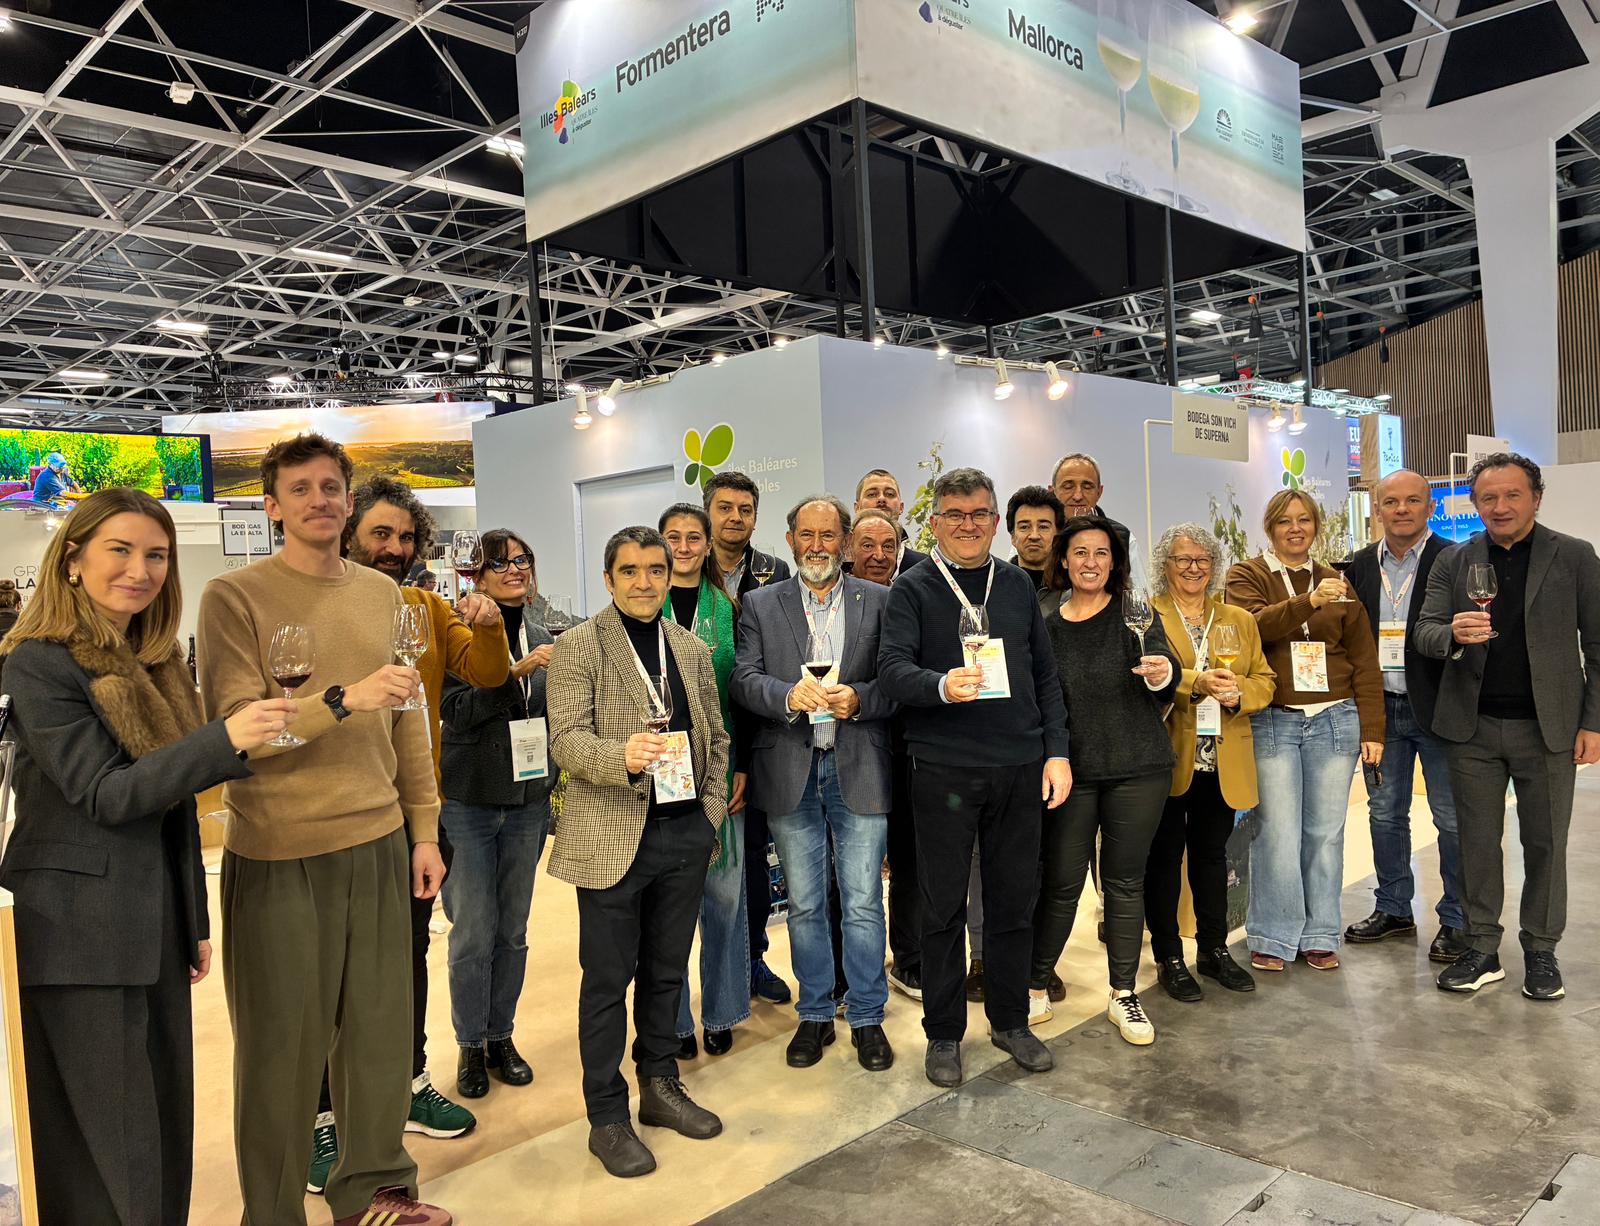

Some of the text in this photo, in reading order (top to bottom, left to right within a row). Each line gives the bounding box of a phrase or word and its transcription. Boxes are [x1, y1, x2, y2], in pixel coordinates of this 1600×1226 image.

[615, 9, 731, 94] Formentera
[1008, 9, 1084, 71] Mallorca
[541, 88, 597, 129] Illes Balears
[1187, 410, 1237, 430] BODEGA SON VICH
[1195, 427, 1230, 443] DE SUPERNA
[748, 456, 798, 474] Baléares
